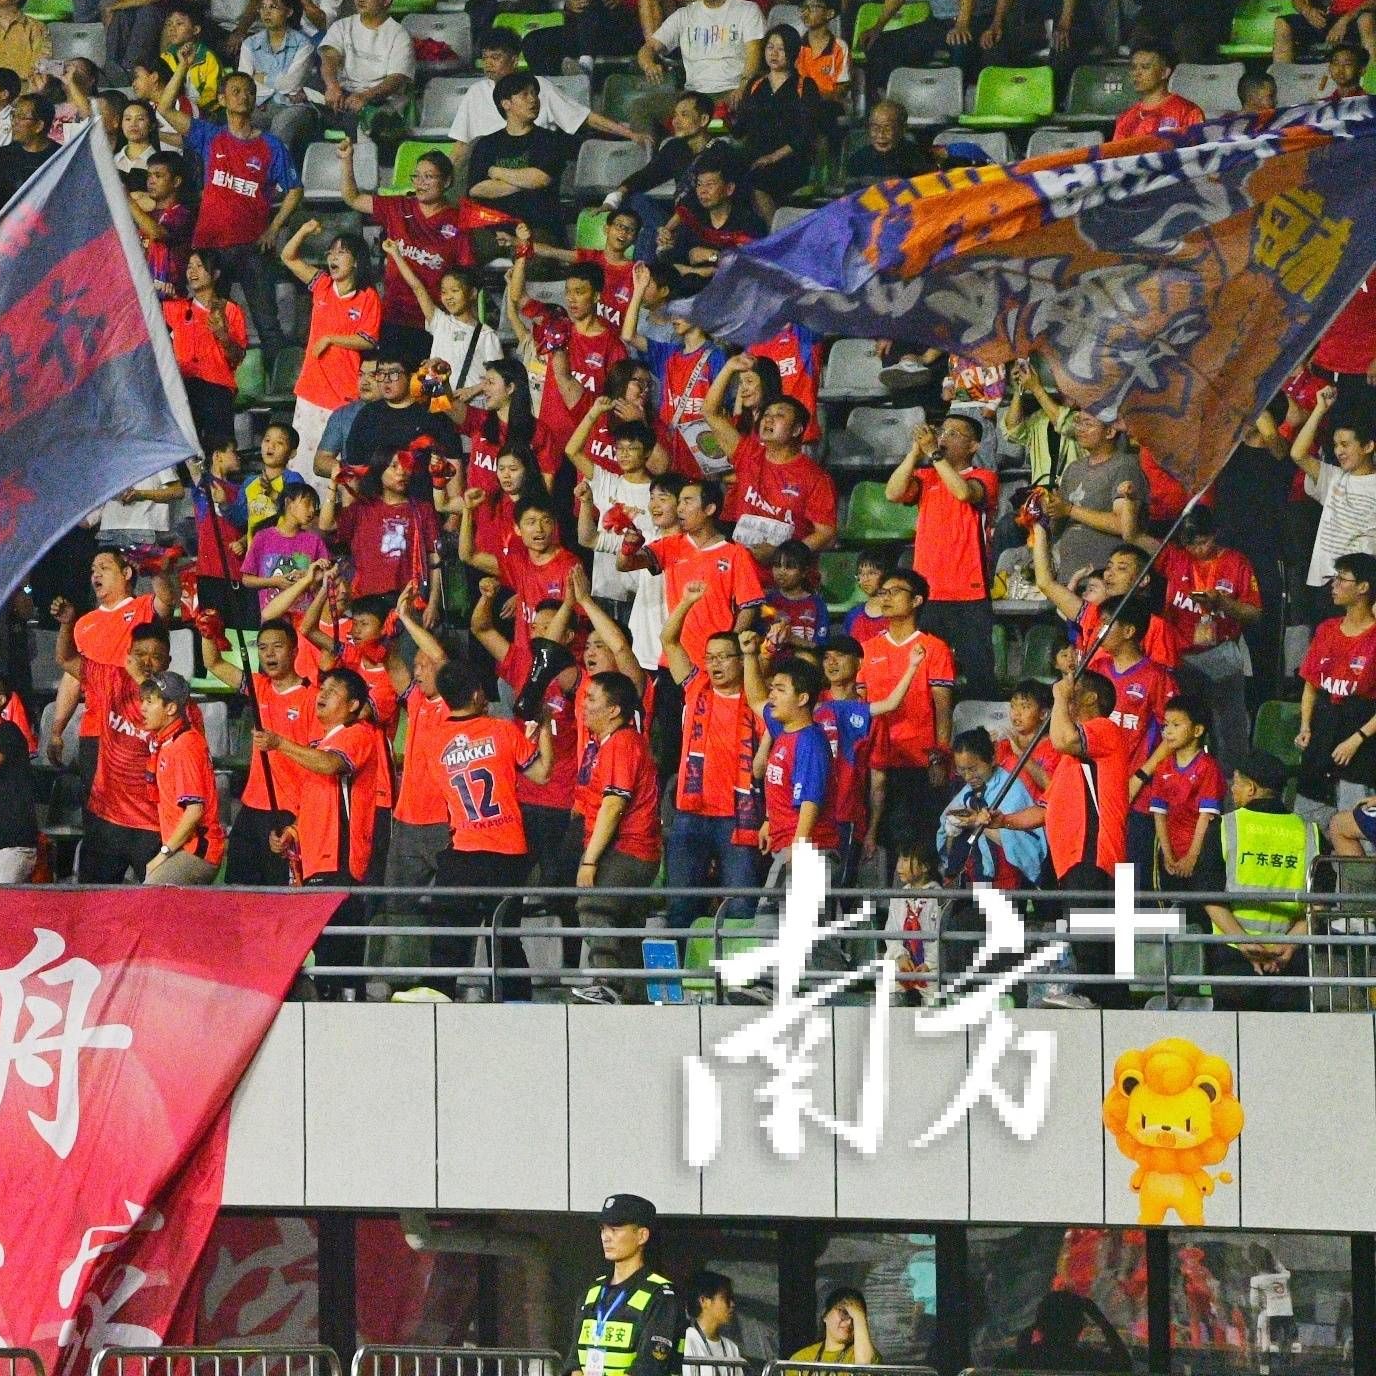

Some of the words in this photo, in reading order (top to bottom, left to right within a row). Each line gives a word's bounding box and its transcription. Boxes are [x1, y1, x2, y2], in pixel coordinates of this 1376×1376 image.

[447, 744, 495, 767] HAKKA
[451, 767, 501, 822] 12
[1240, 850, 1299, 870] 广东客安
